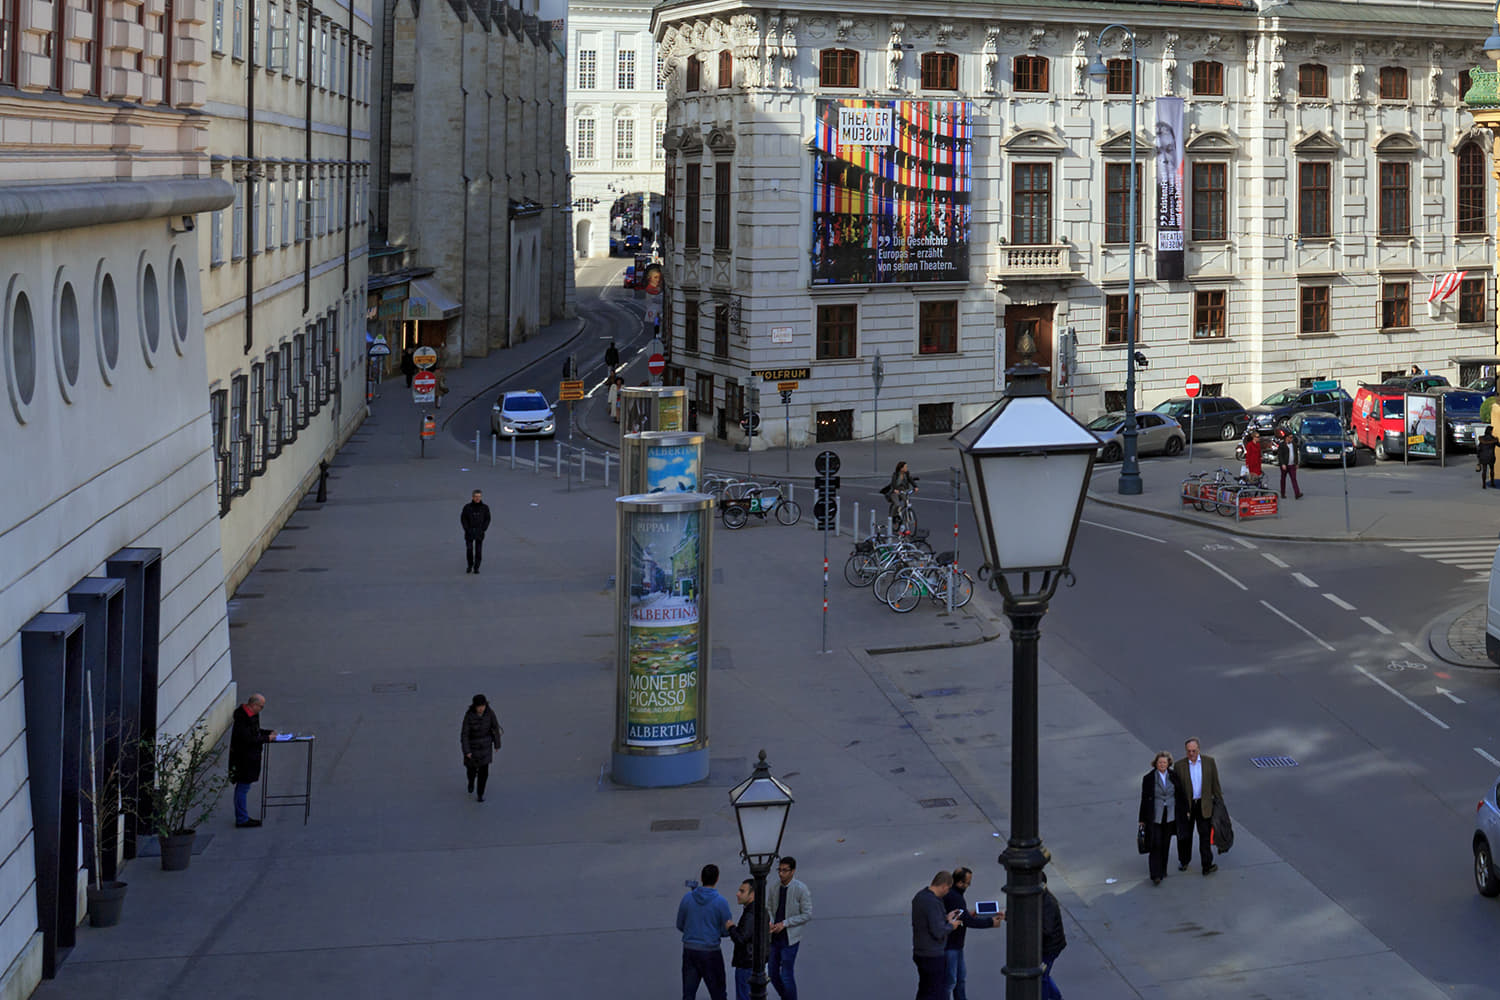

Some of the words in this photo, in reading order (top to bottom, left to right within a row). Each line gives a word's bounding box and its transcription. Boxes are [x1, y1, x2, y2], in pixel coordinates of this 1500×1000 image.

[841, 111, 889, 126] THEAER
[893, 235, 906, 246] Die
[907, 235, 948, 247] Geschichte
[878, 248, 909, 261] Europas
[916, 248, 943, 258] erzählt
[878, 262, 892, 271] von
[893, 261, 918, 271] seinen
[755, 369, 807, 380] WOLFRUM
[632, 606, 697, 620] ALBERTINA
[630, 674, 677, 690] MONET
[679, 671, 697, 688] BIS
[630, 689, 686, 706] PICASSO
[629, 722, 695, 738] ALBERTINA
